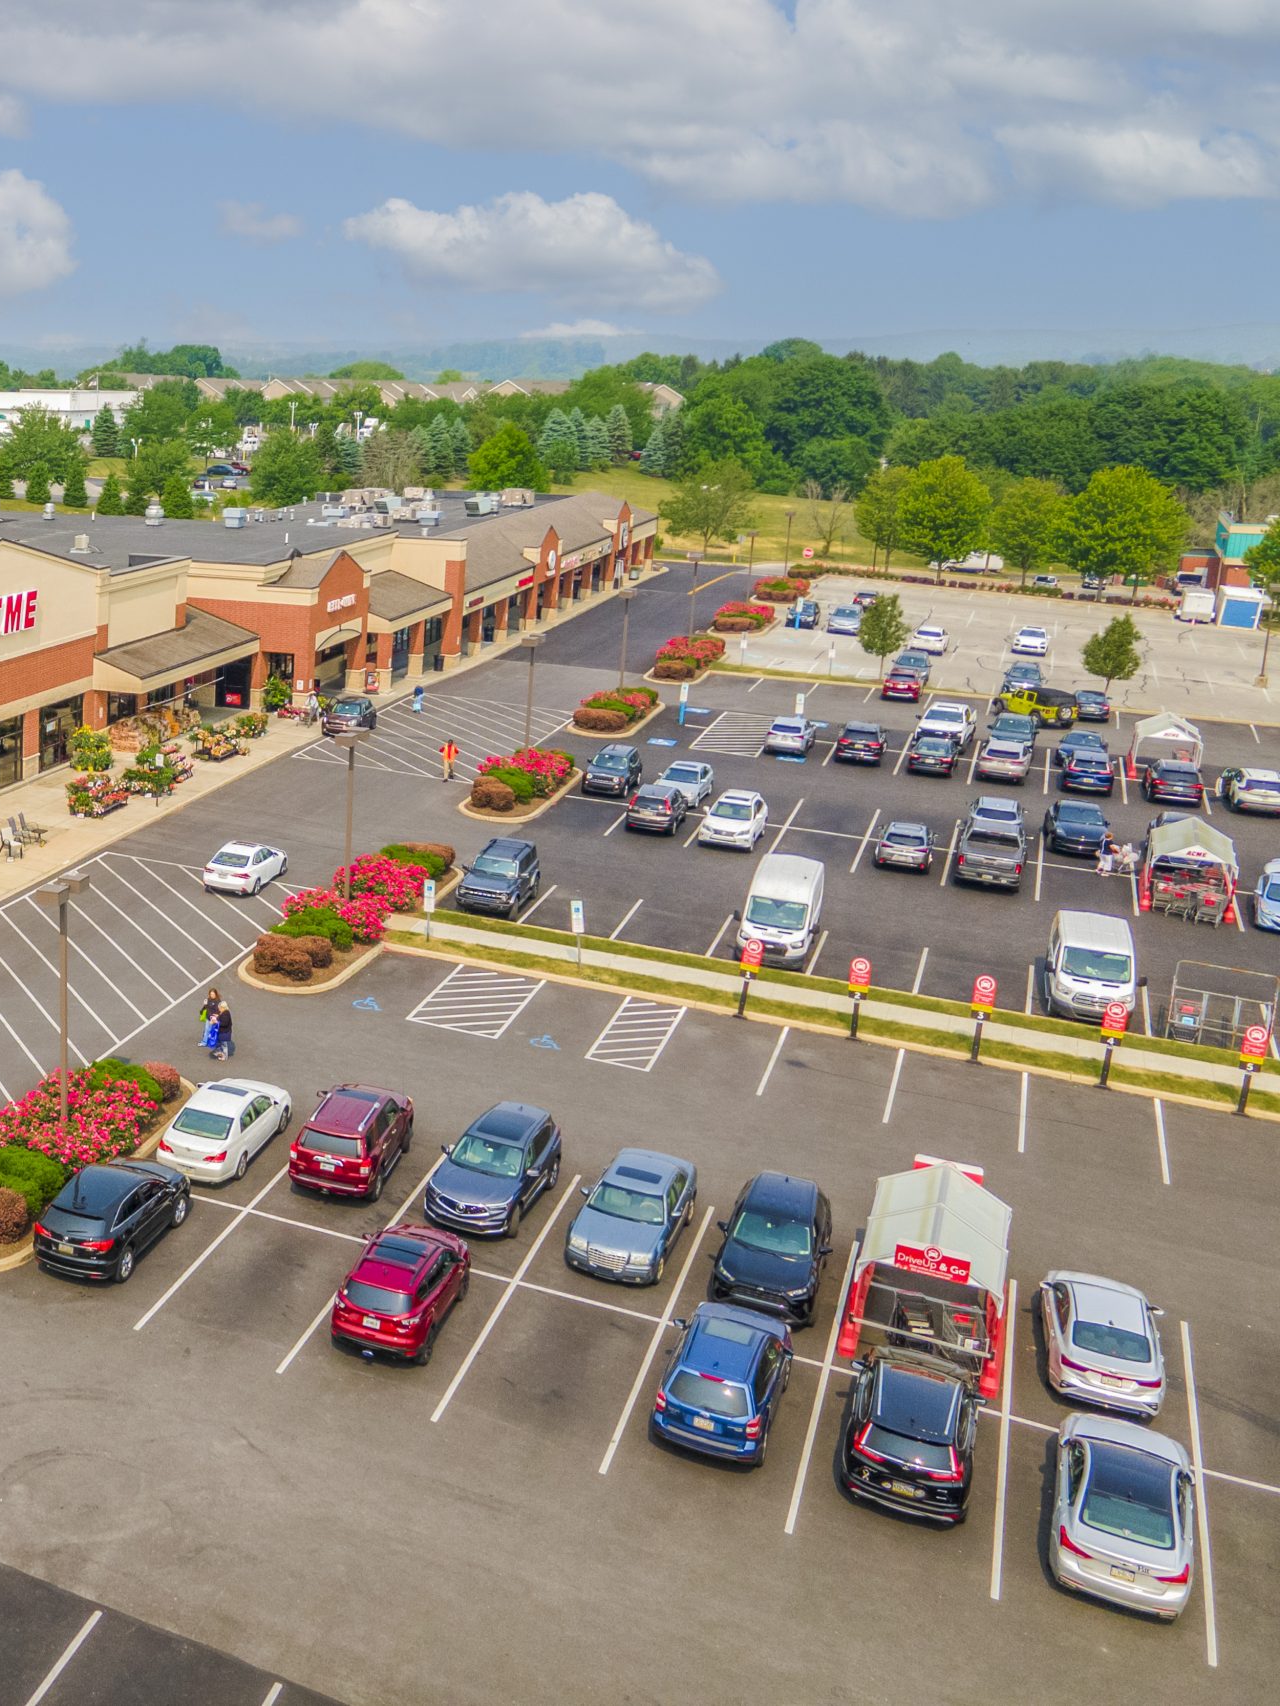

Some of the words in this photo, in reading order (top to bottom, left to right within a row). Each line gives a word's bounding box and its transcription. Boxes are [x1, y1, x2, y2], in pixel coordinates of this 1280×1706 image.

[977, 1011, 984, 1019] 3
[897, 1252, 937, 1271] DriveUp
[939, 1262, 948, 1272] &
[950, 1265, 967, 1276] Go
